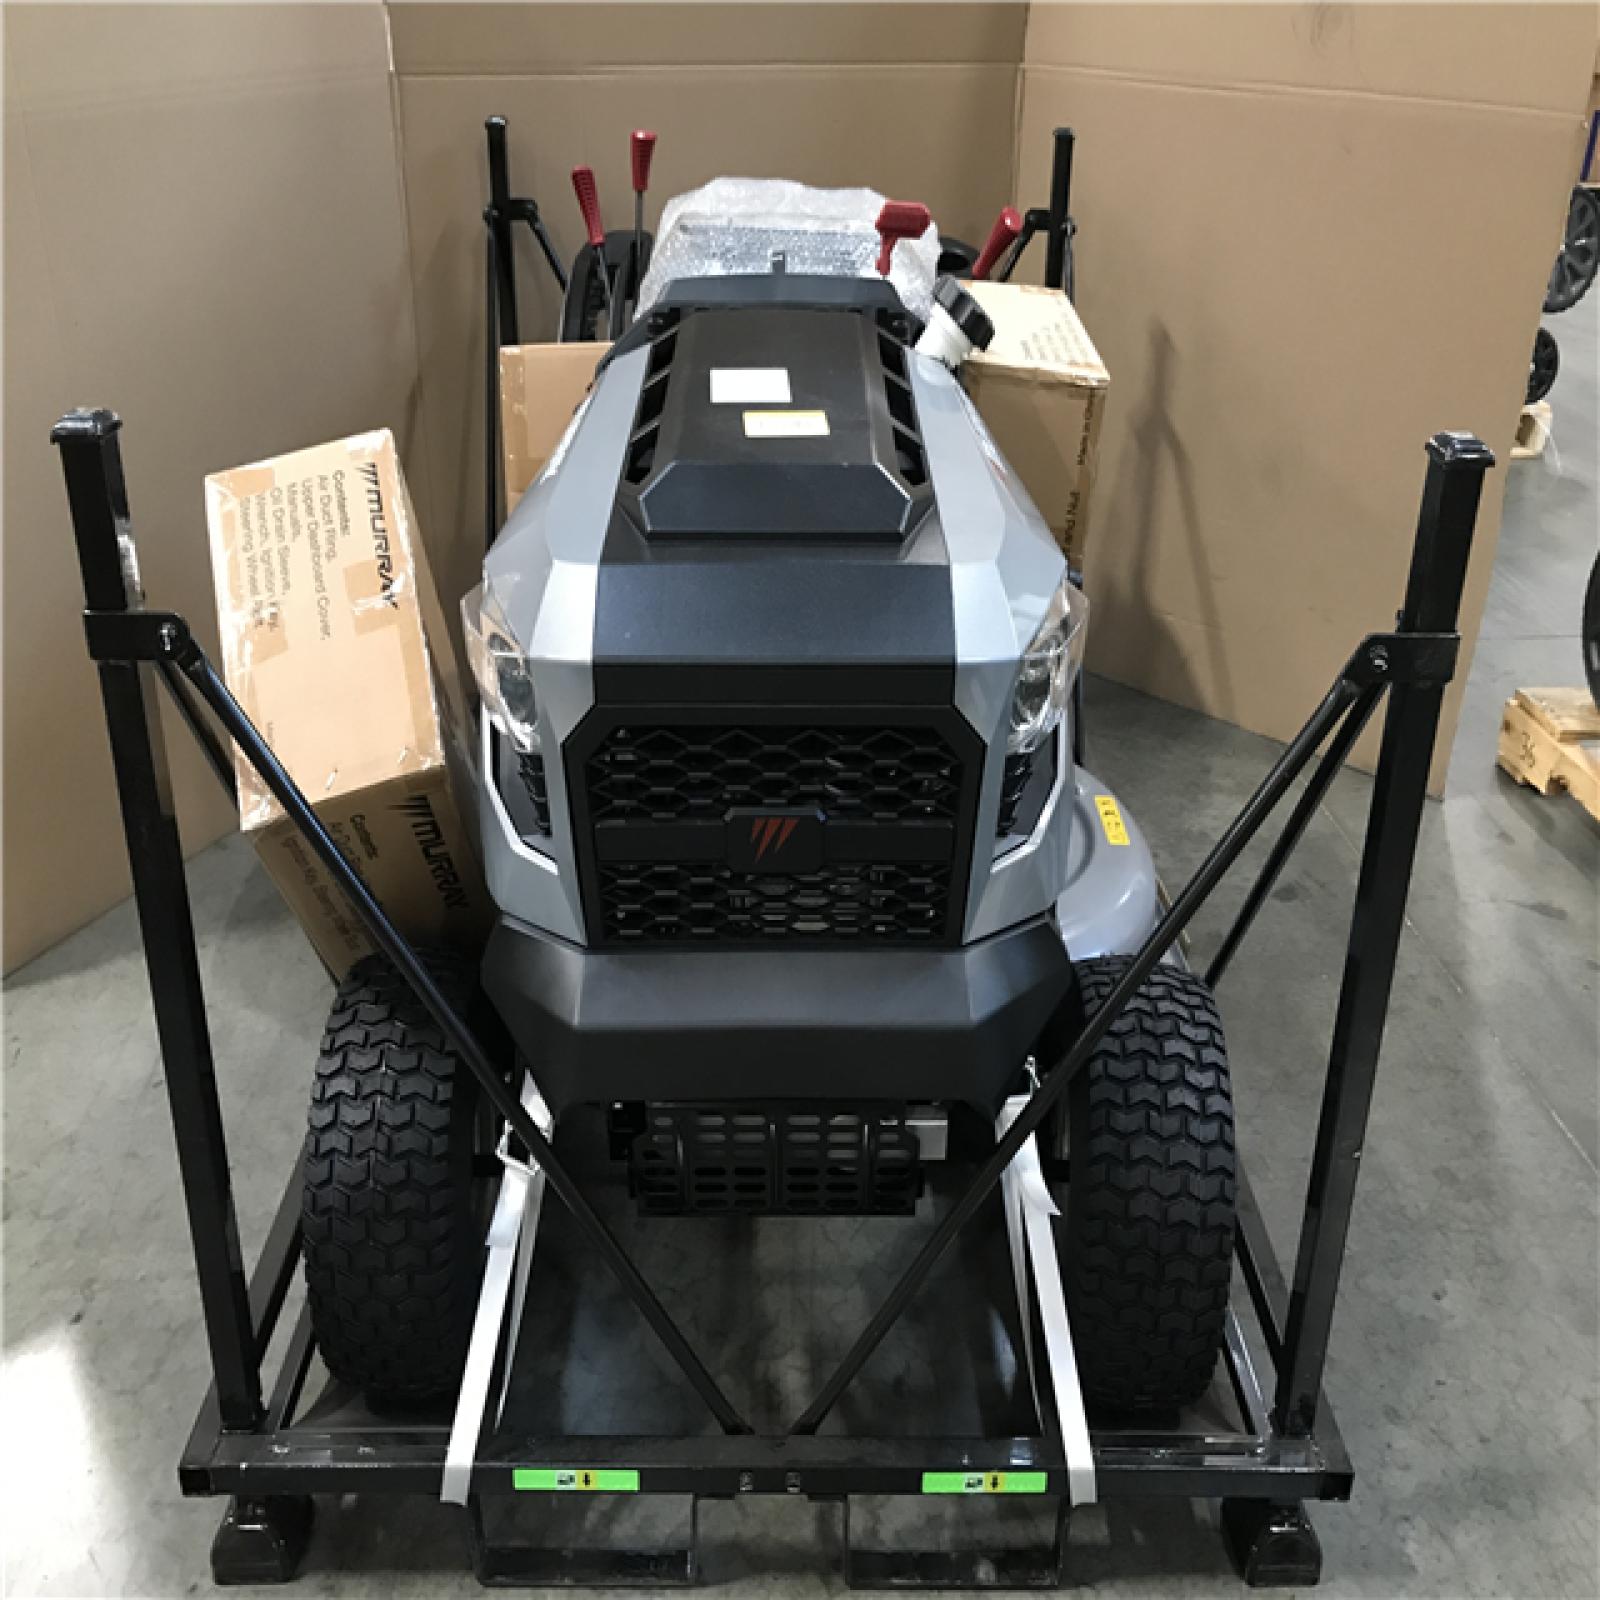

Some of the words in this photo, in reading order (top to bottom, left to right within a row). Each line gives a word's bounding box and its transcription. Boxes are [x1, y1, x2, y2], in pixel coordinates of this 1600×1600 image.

[272, 508, 286, 544] Drain
[301, 477, 316, 519] Upper
[319, 494, 334, 526] Duct
[306, 520, 327, 594] Dashboard
[366, 489, 398, 609] MURRAY
[411, 821, 471, 908] MURRAY
